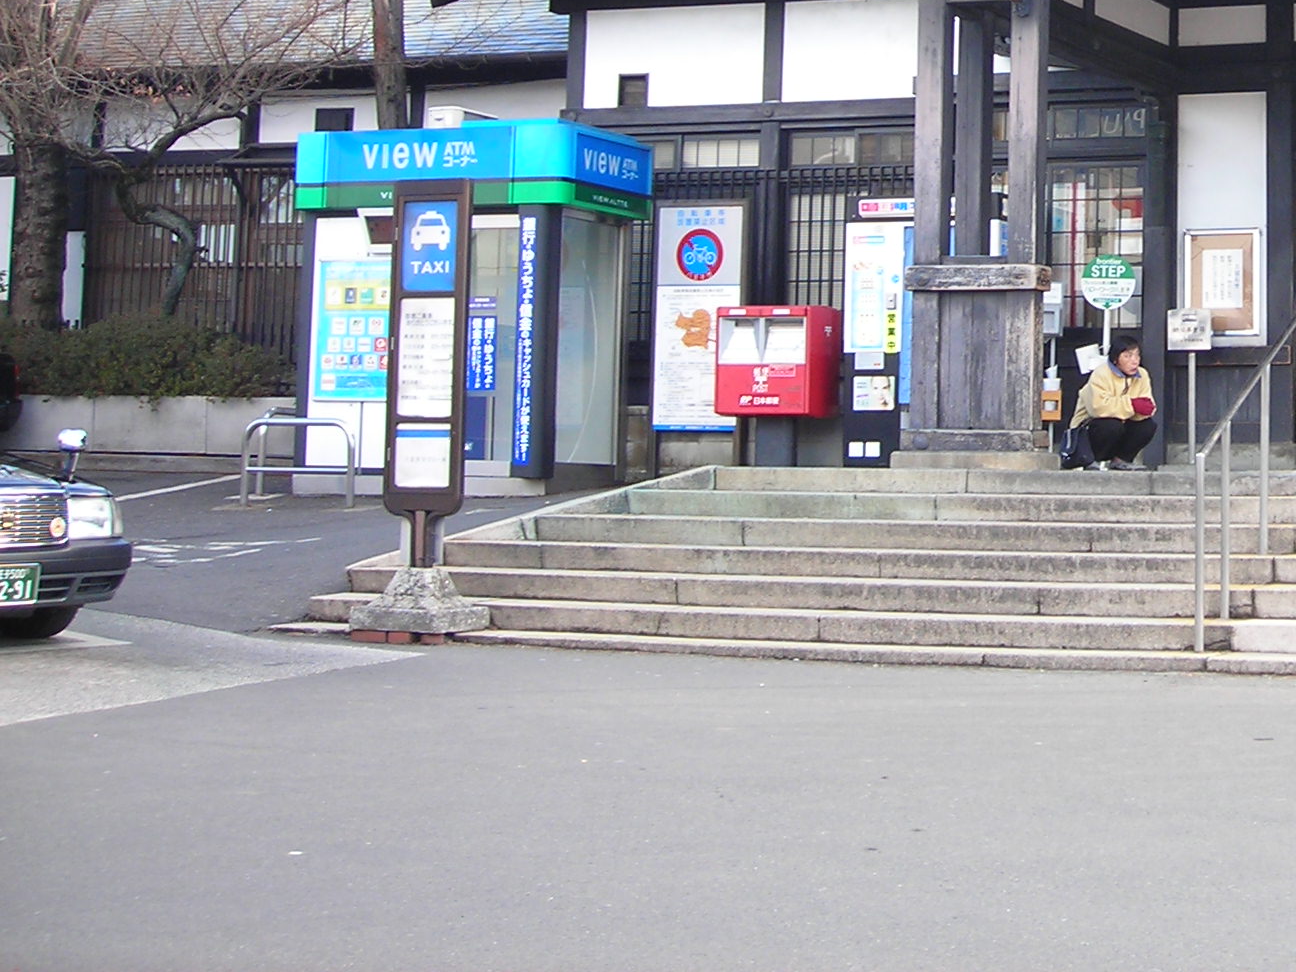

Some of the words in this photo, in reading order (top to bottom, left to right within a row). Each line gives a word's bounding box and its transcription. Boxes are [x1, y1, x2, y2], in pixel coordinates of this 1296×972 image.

[443, 141, 476, 156] ATM
[442, 156, 478, 167] コーナー
[410, 260, 450, 275] TAXI
[1091, 264, 1126, 277] STEP
